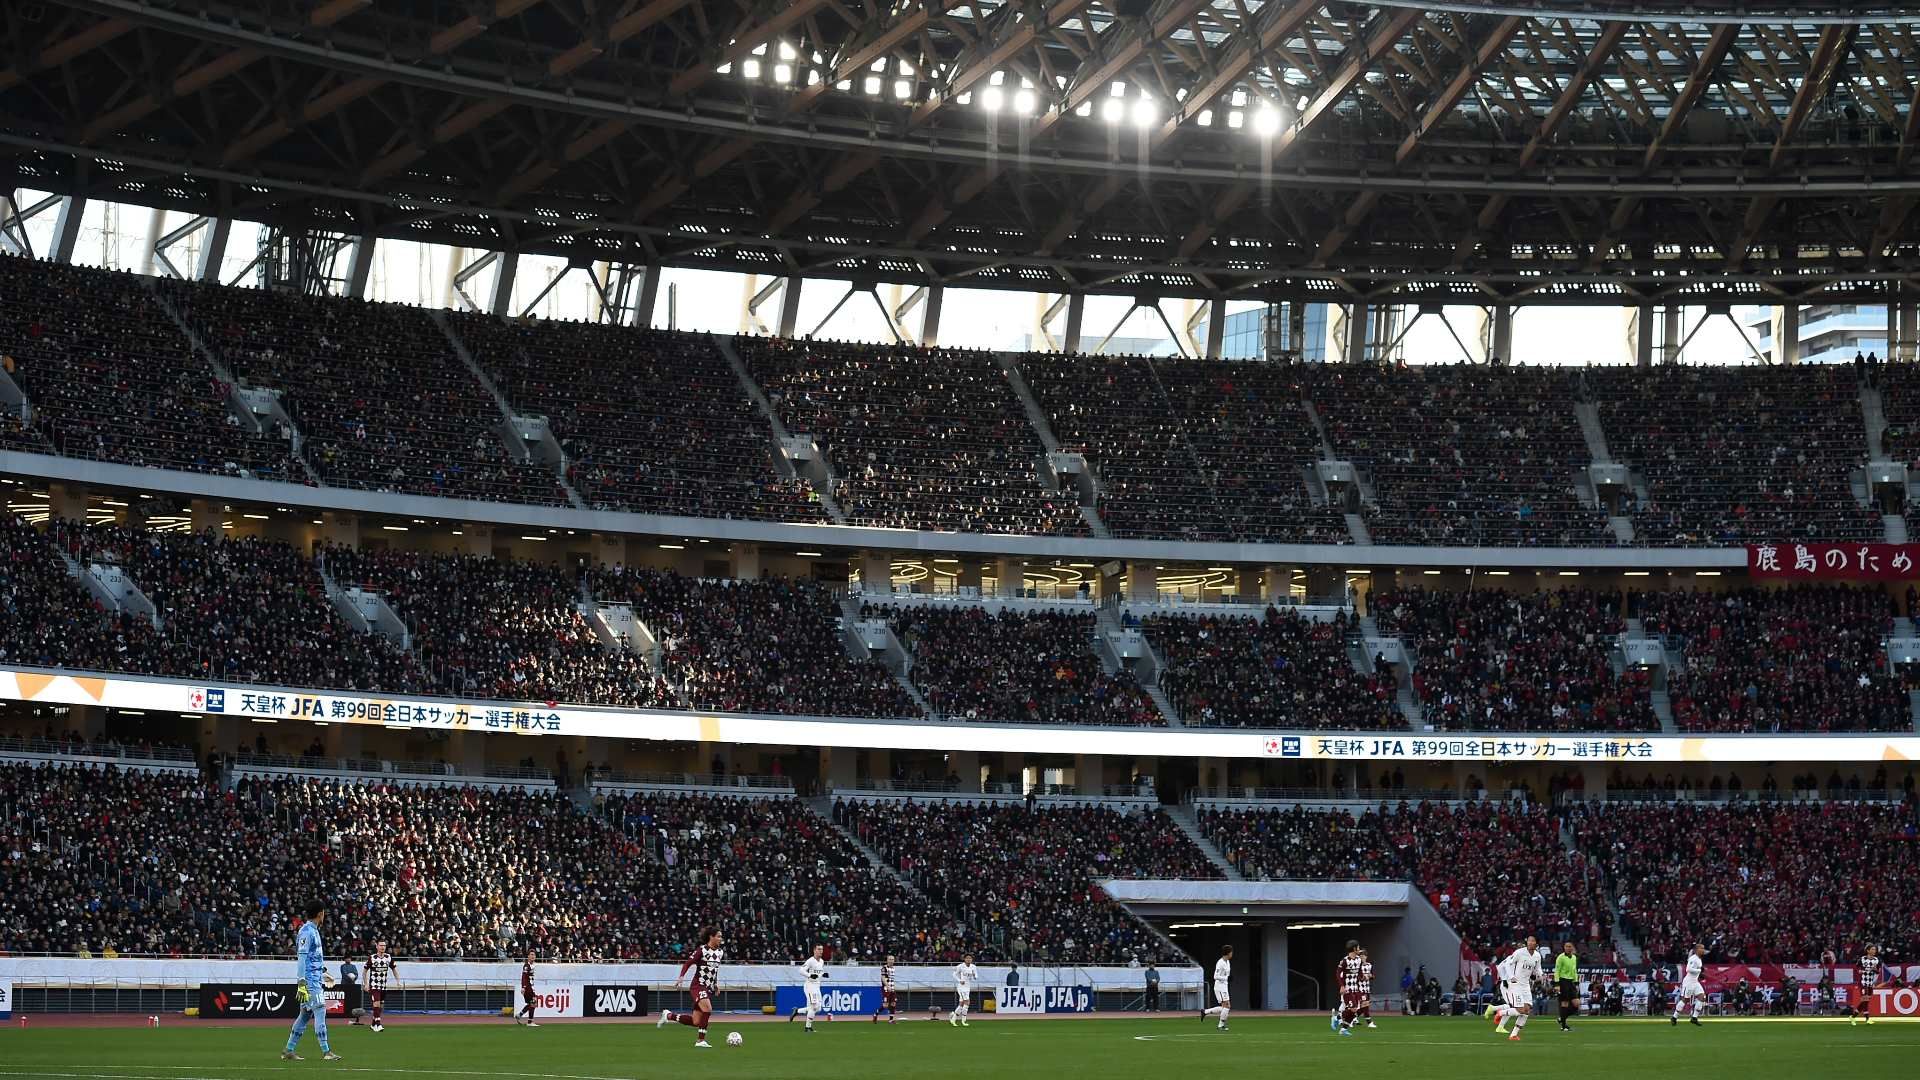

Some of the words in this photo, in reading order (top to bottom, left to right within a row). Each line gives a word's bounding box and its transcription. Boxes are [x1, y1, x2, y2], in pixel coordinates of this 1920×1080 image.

[1756, 544, 1912, 573] 鹿島のため
[241, 694, 286, 714] 天皇杯
[291, 698, 324, 717] JFA
[331, 700, 561, 731] 第99回全日本サッカー選手権大会
[1318, 739, 1364, 756] 天皇杯
[1370, 740, 1405, 756] JFA
[1412, 740, 1653, 758] 第99回全日本サッカー選手権大会
[230, 991, 286, 1012] ニチバン
[594, 989, 637, 1013] SAVAS
[1001, 987, 1042, 1011] JFA.jp
[1048, 987, 1088, 1011] JFA.jp
[1872, 988, 1920, 1015] TO
